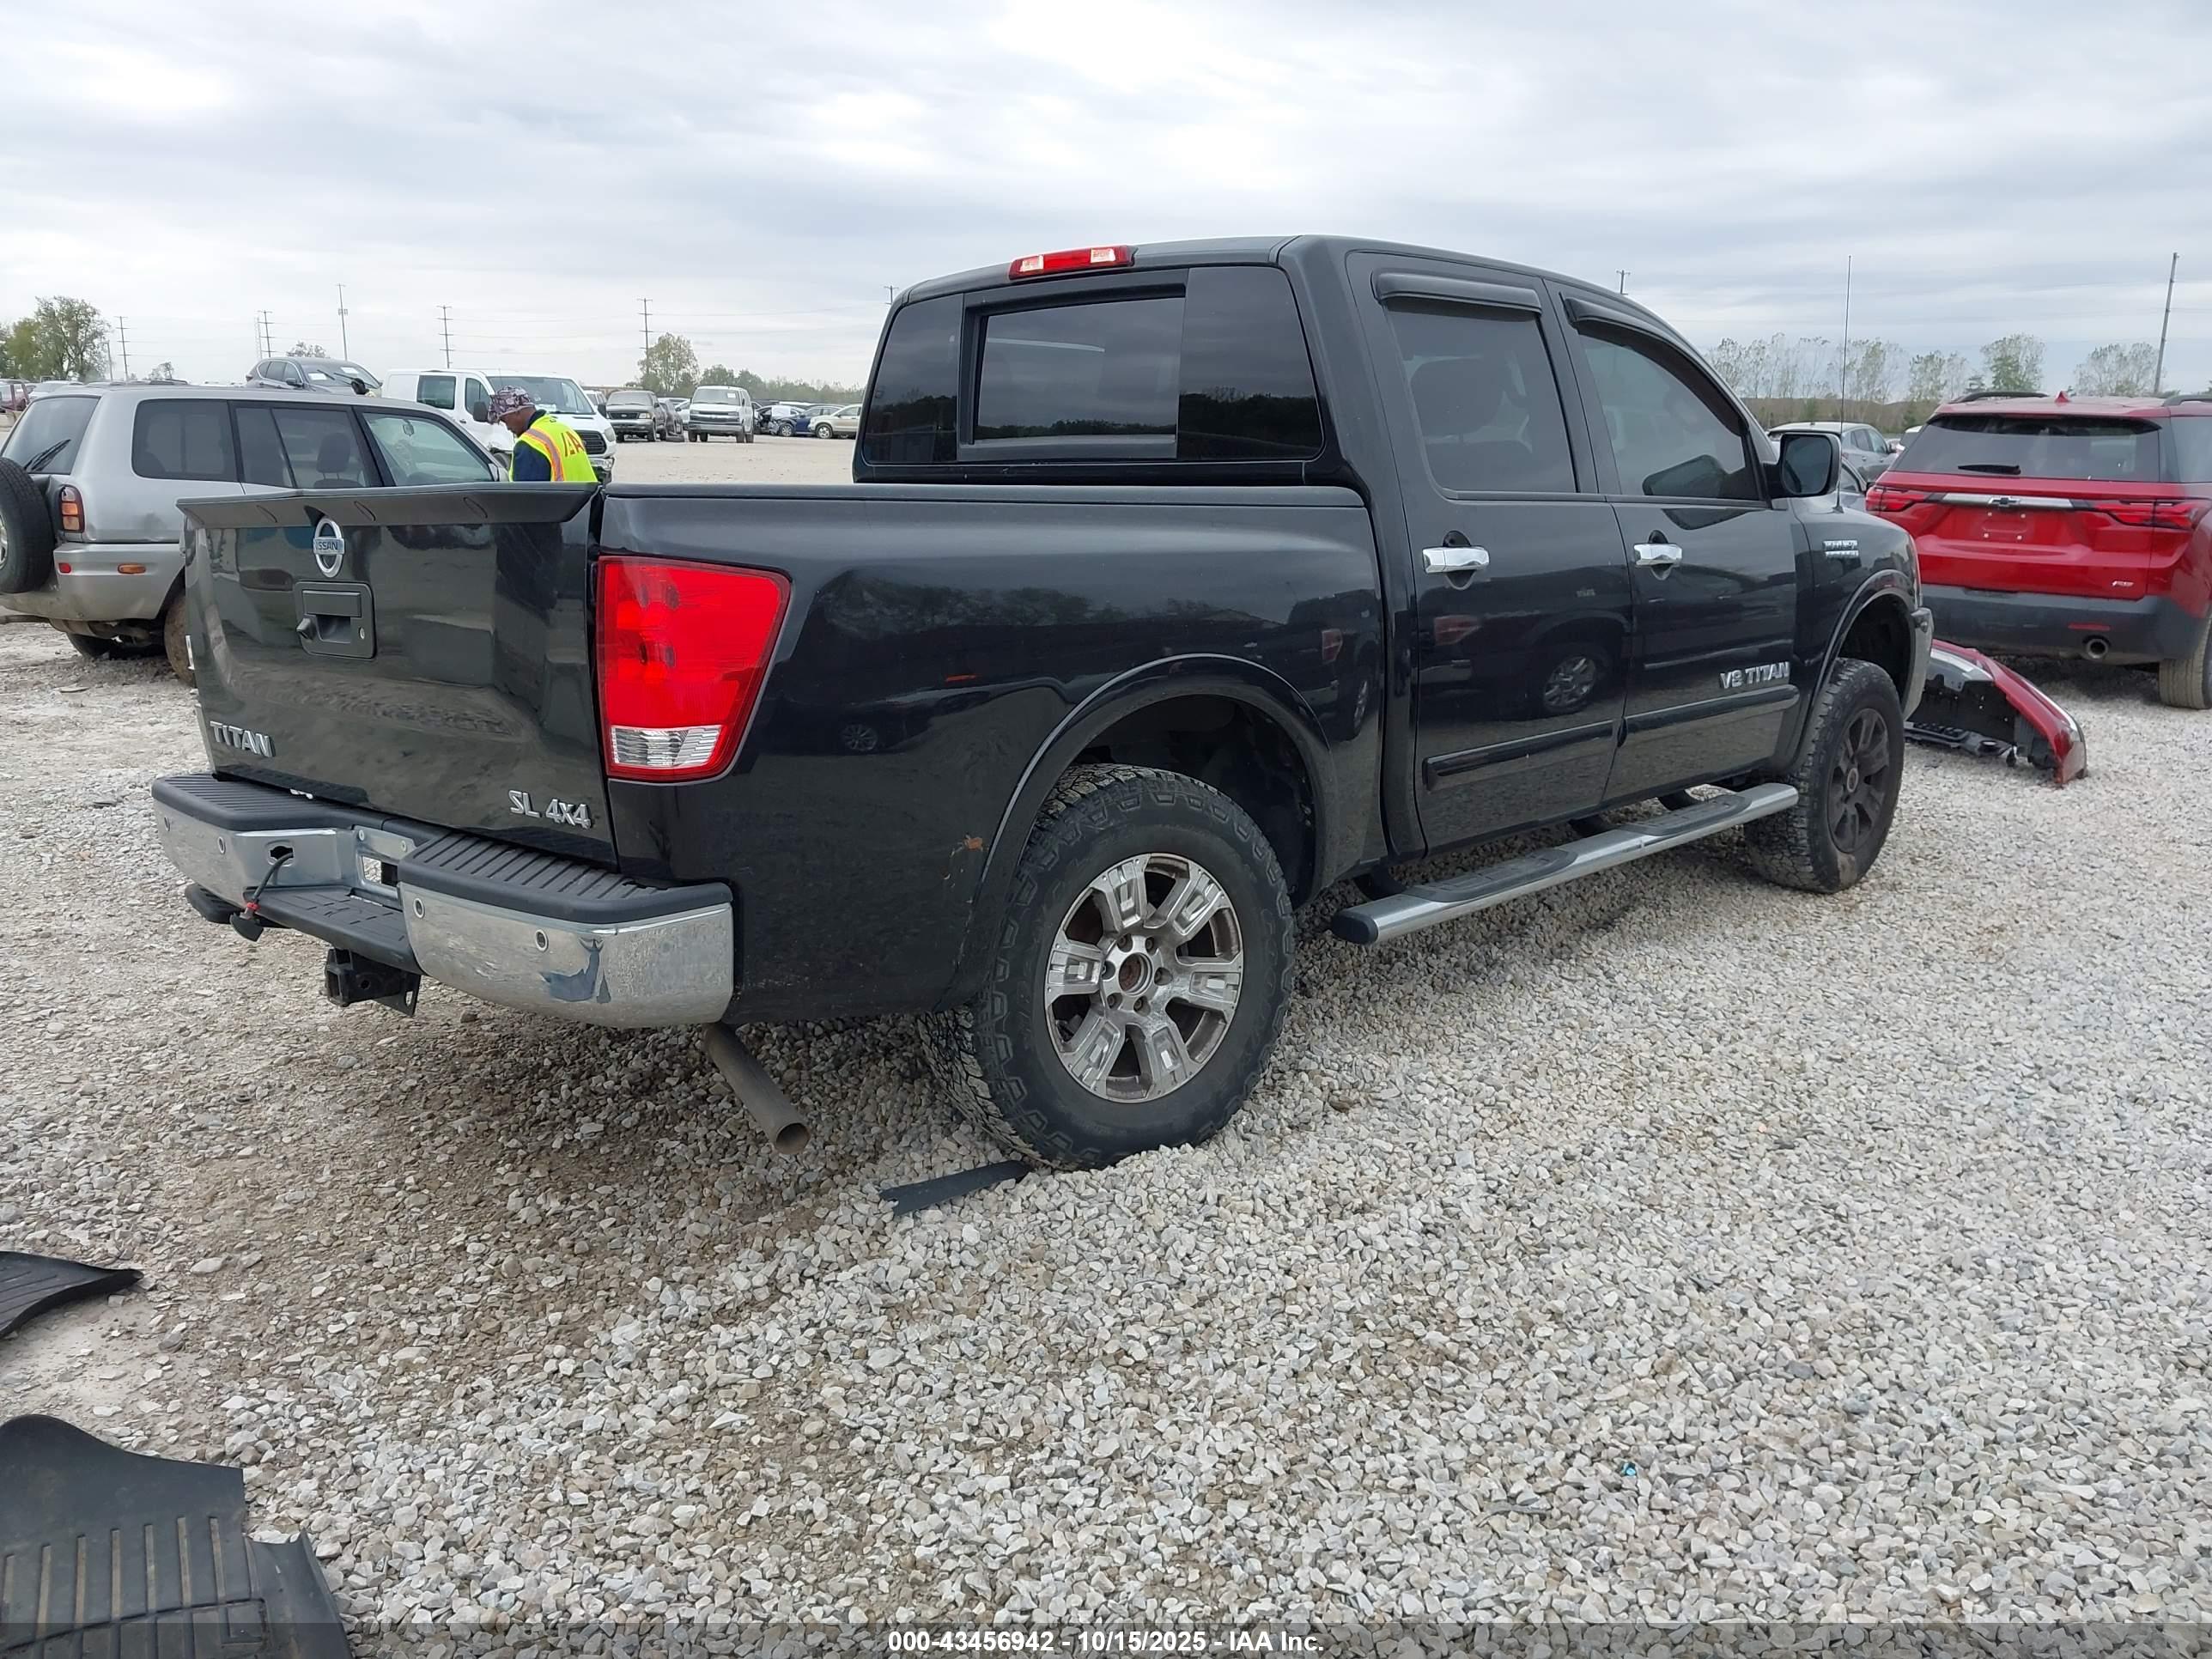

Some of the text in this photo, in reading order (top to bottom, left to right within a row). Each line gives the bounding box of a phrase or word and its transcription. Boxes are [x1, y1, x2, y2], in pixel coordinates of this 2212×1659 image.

[1720, 661, 1790, 690] V8 TITAN
[210, 720, 275, 757] TITAN
[508, 789, 541, 818] SL
